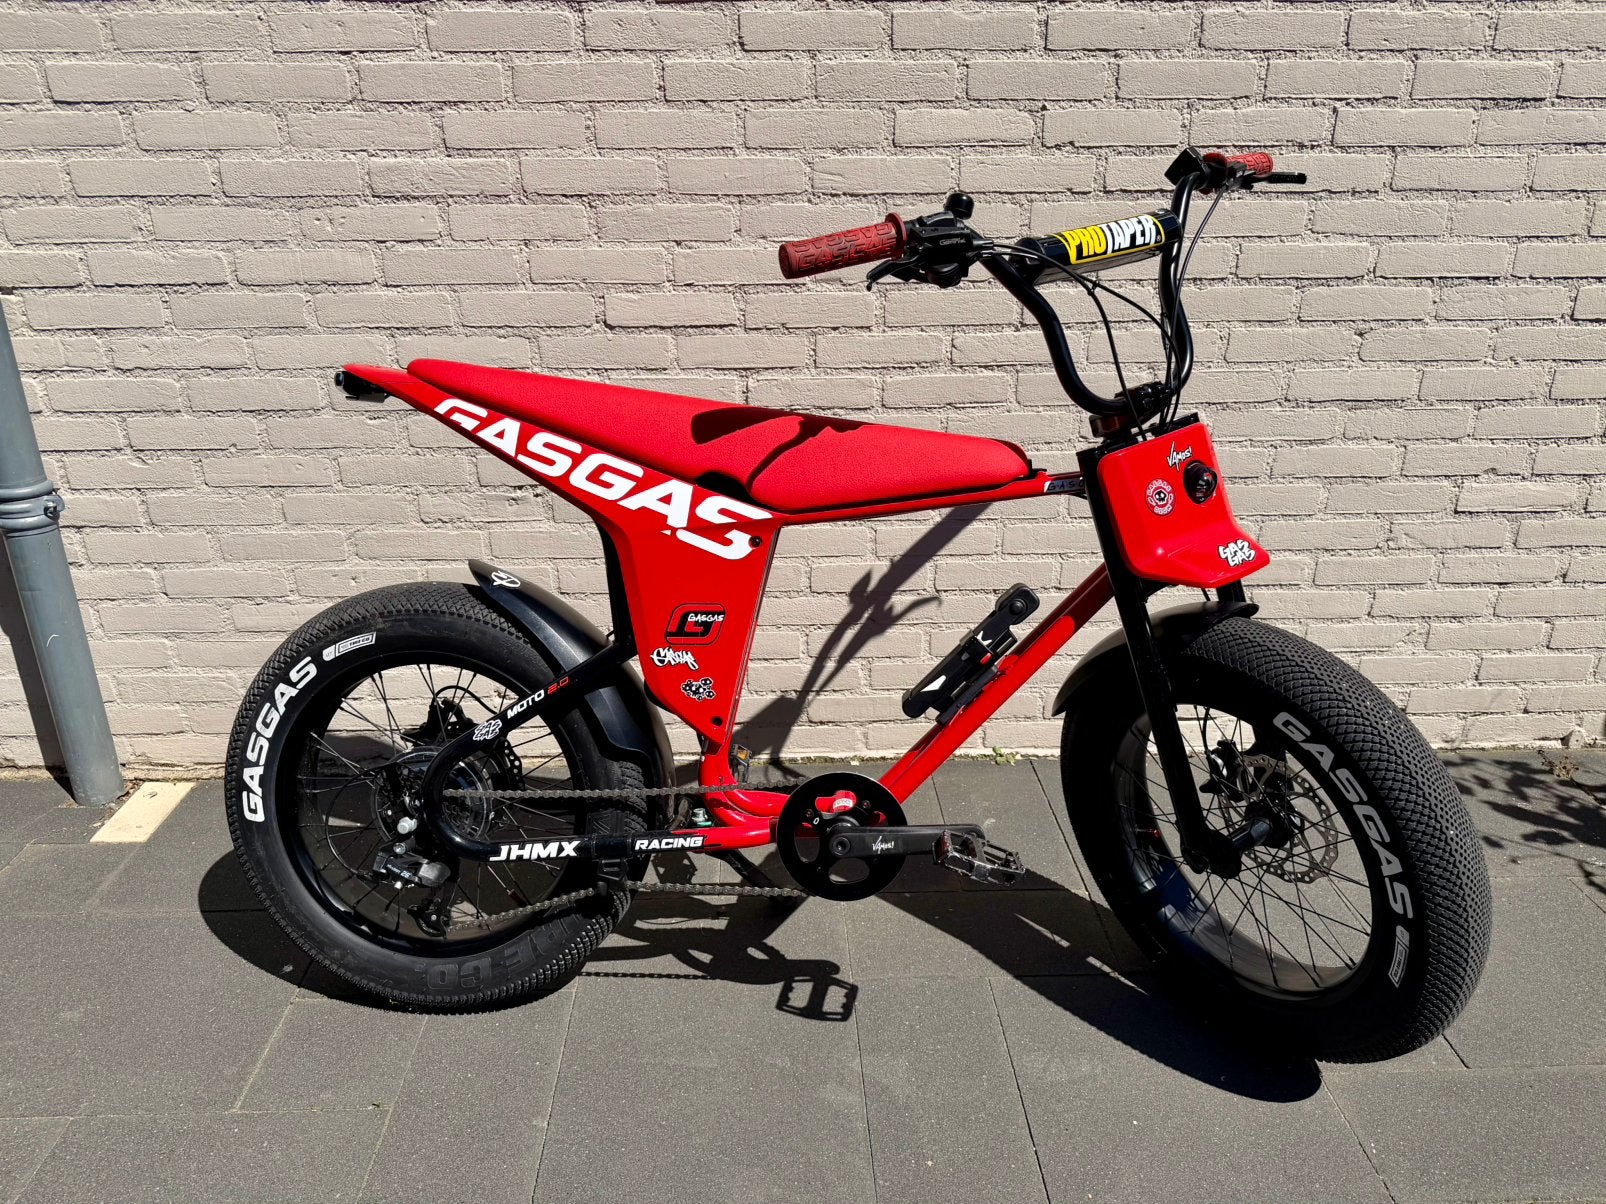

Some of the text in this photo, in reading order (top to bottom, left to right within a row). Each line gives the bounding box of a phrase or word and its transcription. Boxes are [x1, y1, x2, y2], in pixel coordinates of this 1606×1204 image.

[1062, 213, 1157, 262] PROTAPER
[1167, 441, 1192, 471] VAMOS!
[434, 398, 773, 560] GASGAS
[687, 613, 724, 622] GASGAS
[507, 677, 570, 719] MOTO 2.0
[242, 656, 317, 822] GASGAS
[1272, 711, 1414, 919] GASGAS
[489, 836, 705, 861] JHMX RACING
